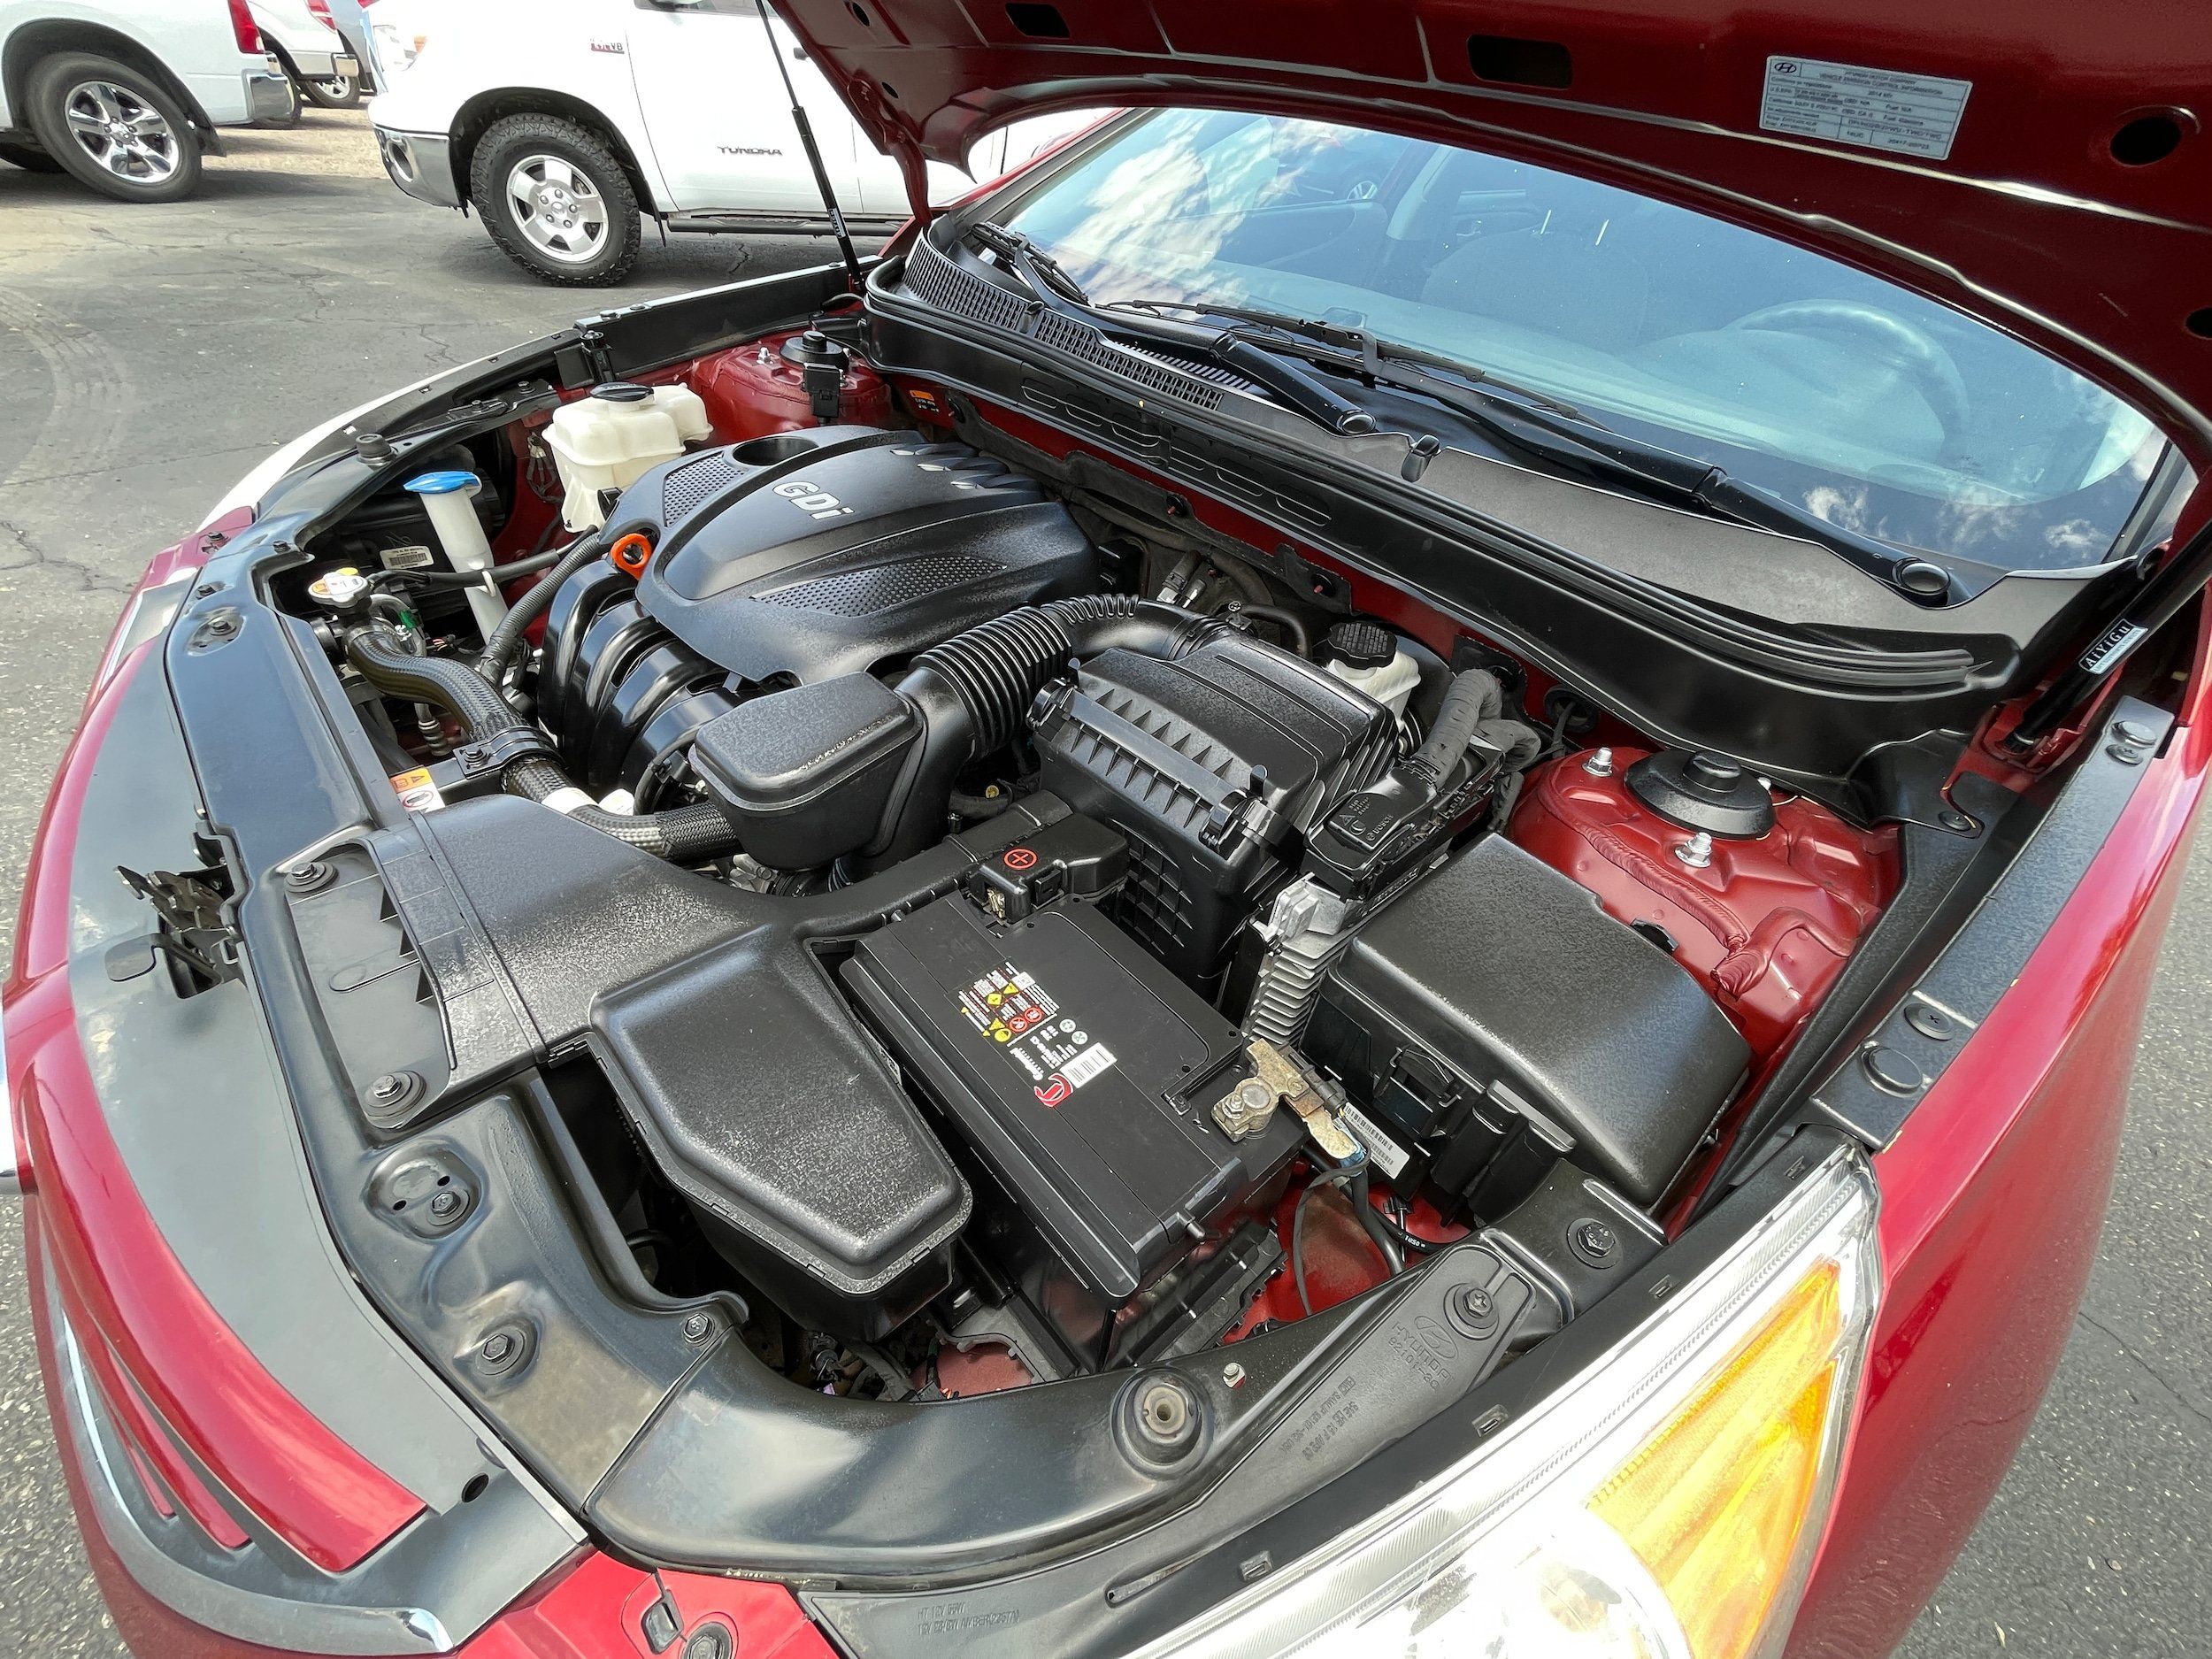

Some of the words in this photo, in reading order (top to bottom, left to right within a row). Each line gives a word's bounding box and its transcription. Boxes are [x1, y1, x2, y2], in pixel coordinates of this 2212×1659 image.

[717, 146, 783, 156] TUNDRA
[772, 480, 855, 520] GDi
[2085, 626, 2131, 667] AiYiGu
[1372, 814, 1394, 834] BOSCH
[1392, 1321, 1455, 1386] HYUNDAI
